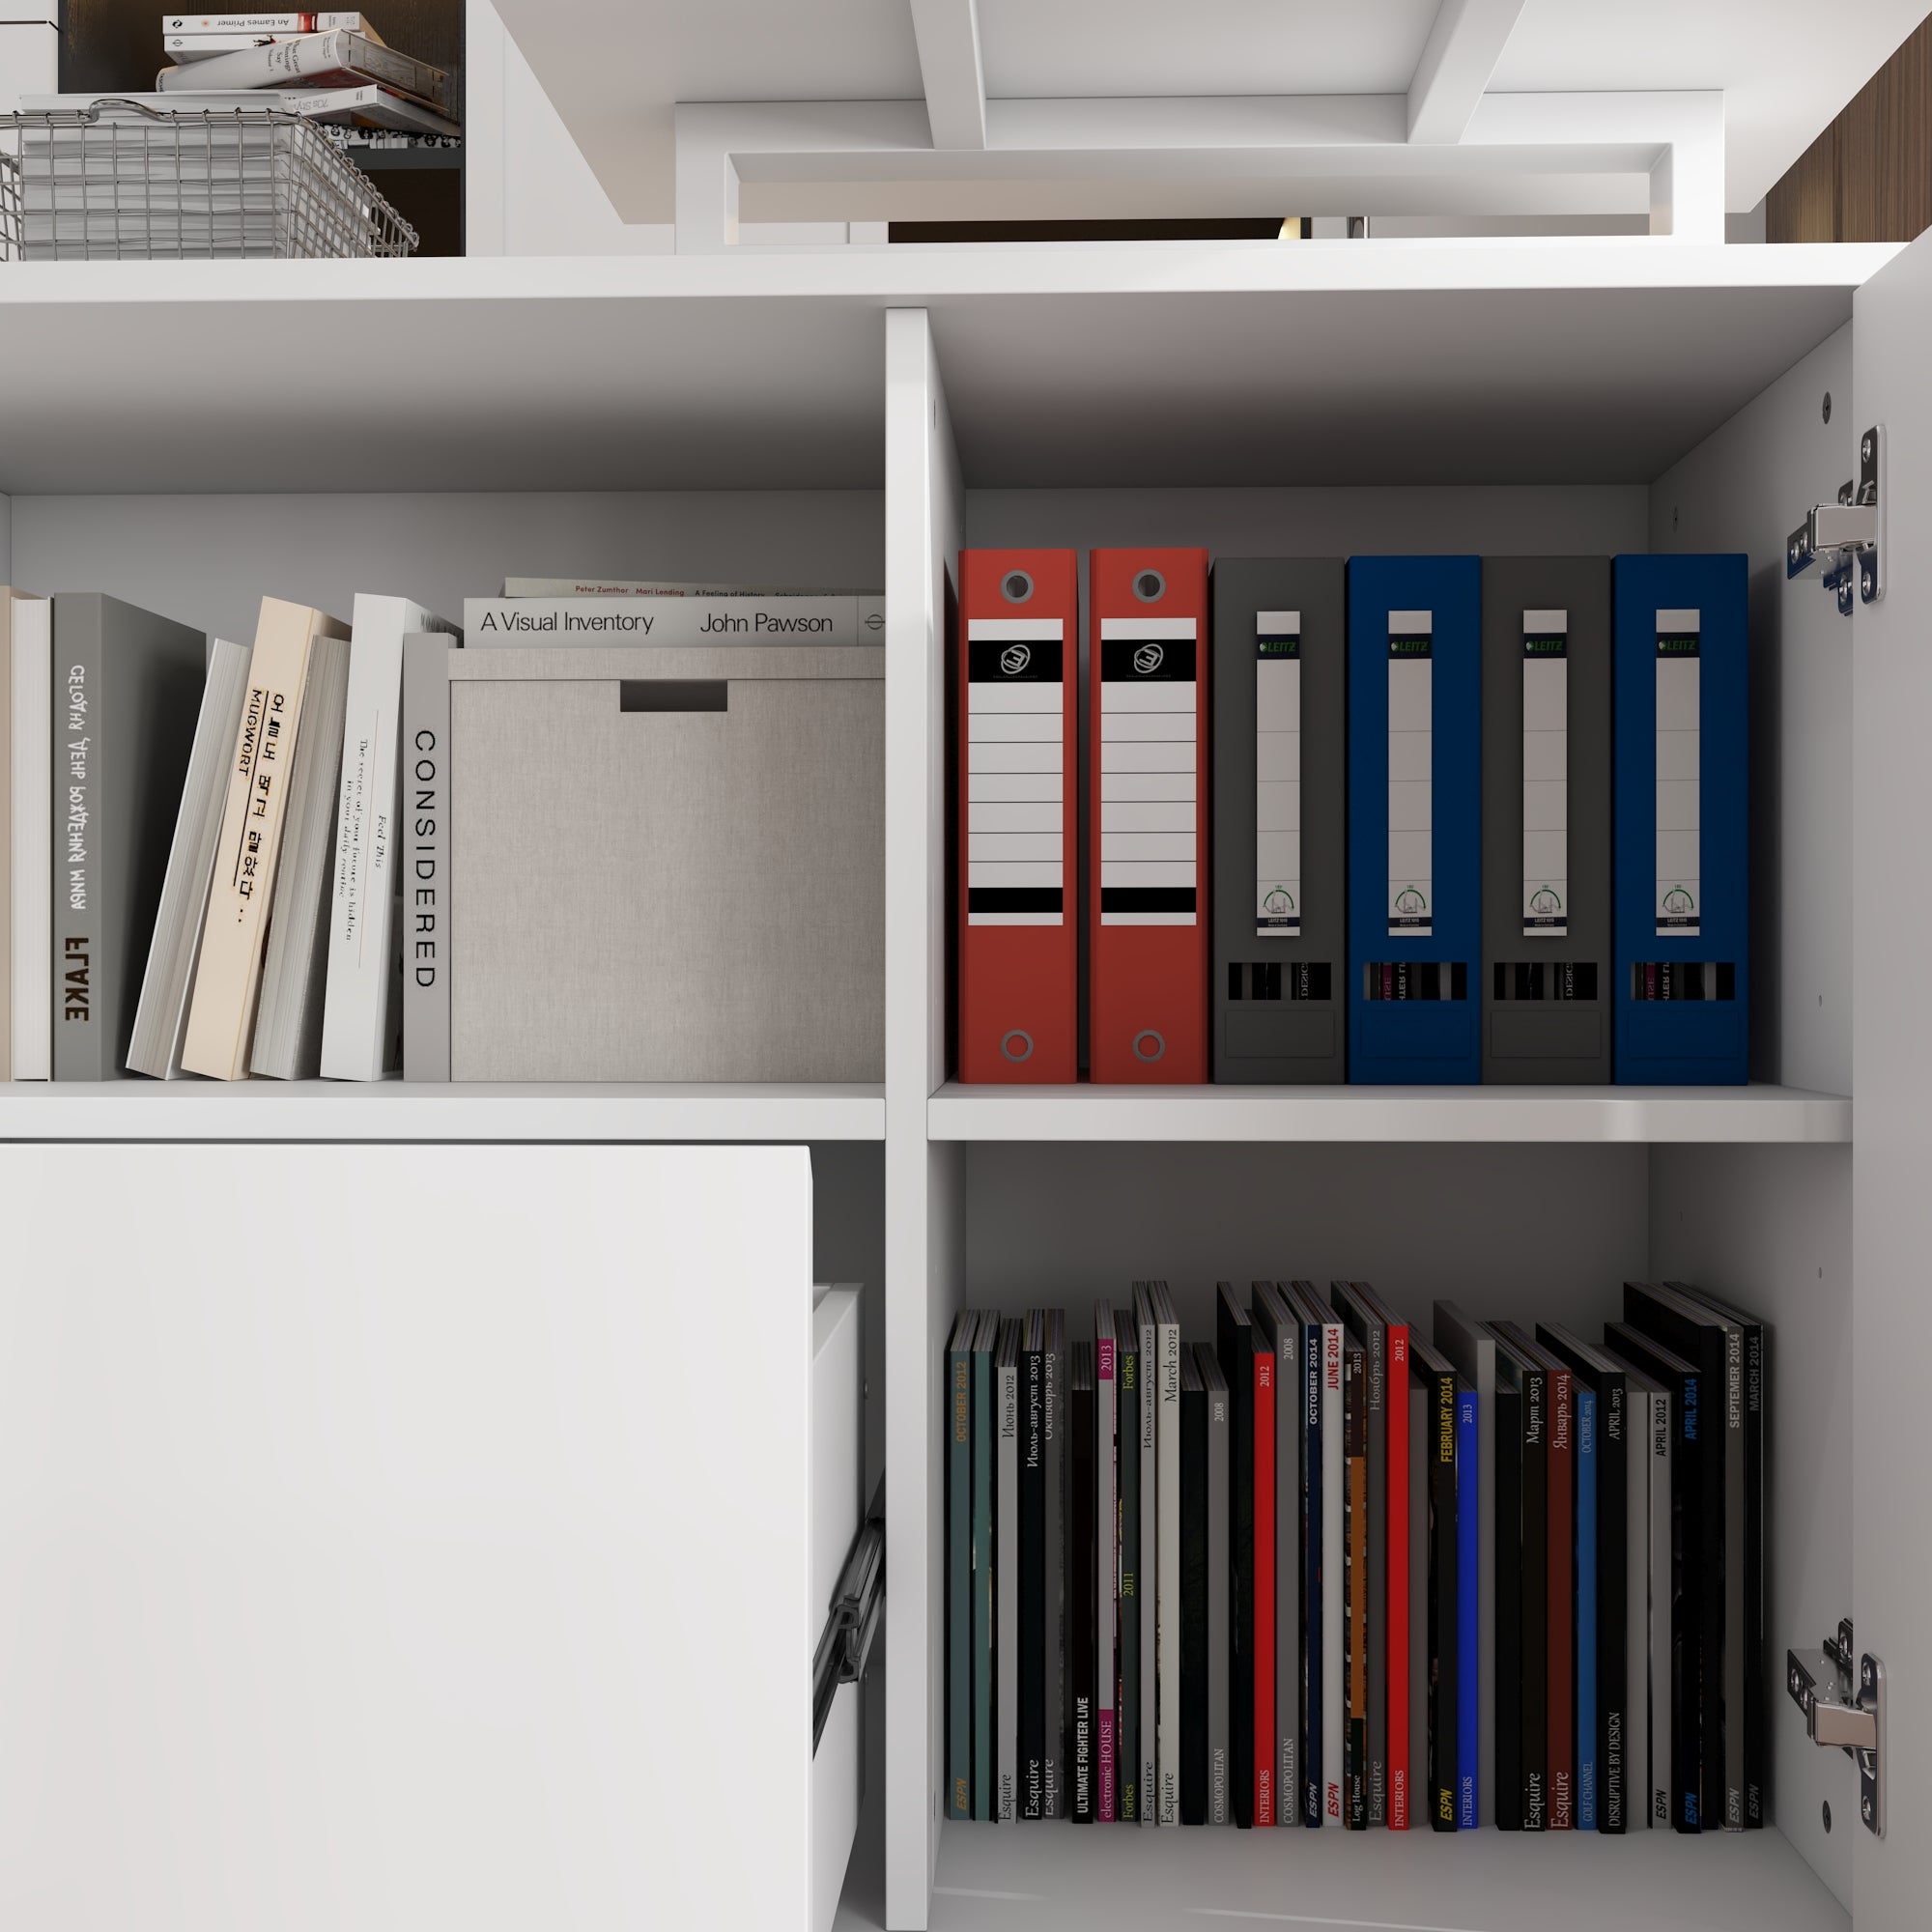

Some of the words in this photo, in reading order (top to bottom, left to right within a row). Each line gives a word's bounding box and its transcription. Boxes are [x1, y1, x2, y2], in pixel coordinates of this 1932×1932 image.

[217, 19, 245, 28] Primer
[292, 55, 301, 73] Great
[313, 98, 328, 109] 70s
[575, 585, 596, 593] Peter
[597, 586, 629, 594] Zumthor
[481, 612, 497, 632] A
[500, 611, 558, 632] Visual
[564, 611, 654, 636] Inventory
[700, 612, 749, 634] John
[755, 613, 834, 633] Pawson
[1268, 642, 1297, 653] LEITZ
[1400, 641, 1429, 652] LEITZ
[1534, 641, 1563, 652] LEITZ
[1667, 640, 1696, 651] LEITZ
[239, 689, 262, 777] MUGWORT
[359, 740, 368, 758] The
[377, 814, 386, 840] Feel
[375, 845, 385, 869] This
[415, 730, 436, 987] CONSIDERED
[346, 901, 356, 940] hidden
[1101, 1345, 1112, 1371] 2013
[1168, 1329, 1177, 1357] 2012
[1283, 1338, 1294, 1360] 2008
[1309, 1338, 1317, 1368] 2014
[1327, 1329, 1338, 1358] 2014
[1394, 1339, 1404, 1362] 2012
[1729, 1333, 1740, 1364] 2014
[1749, 1336, 1759, 1367] 2014
[955, 1361, 967, 1389] 2012
[1030, 1355, 1041, 1381] 2013
[1045, 1353, 1055, 1379] 2013
[1122, 1355, 1134, 1390] Forbes
[1260, 1366, 1270, 1387] 2012
[1327, 1361, 1338, 1390] JUNE
[1353, 1353, 1362, 1374] 2013
[1006, 1375, 1014, 1400] 2012
[1163, 1360, 1177, 1402] March
[1369, 1361, 1383, 1411] Ноябрь
[1440, 1377, 1453, 1405] 2014
[1531, 1377, 1543, 1403] 2013
[1557, 1374, 1570, 1401] 2014
[1685, 1378, 1697, 1406] 2014
[1729, 1366, 1740, 1428] SEPTEMER
[1749, 1369, 1759, 1411] MARCH
[1143, 1360, 1154, 1449] Июль-август
[1214, 1402, 1224, 1422] 2008
[1309, 1370, 1317, 1425] OCTOBER
[1463, 1404, 1473, 1423] 2013
[1584, 1400, 1595, 1416] 2014
[1612, 1388, 1624, 1408] 2013
[1656, 1399, 1666, 1424] 2012
[955, 1392, 967, 1443] OCTOBER
[1002, 1403, 1014, 1438] Июнь
[1026, 1384, 1042, 1468] Июль-август
[1525, 1406, 1544, 1444] Март
[1552, 1403, 1572, 1449] Январь
[1609, 1408, 1620, 1440] APRIL
[1685, 1407, 1697, 1440] APRIL
[1440, 1406, 1453, 1463] FEBRUARY
[1581, 1416, 1592, 1453] OCTOBER
[1656, 1427, 1666, 1457] APRIL
[1123, 1572, 1134, 1597] 2011
[1077, 1697, 1089, 1719] LIVE
[1077, 1721, 1089, 1763] FIGHTER
[1101, 1720, 1112, 1763] HOUSE
[1608, 1712, 1621, 1750] DESIGN
[1608, 1752, 1621, 1765] BY
[956, 1777, 966, 1810] ESPN
[1025, 1759, 1043, 1817] Esquire
[1045, 1759, 1059, 1816] Esquire
[1077, 1765, 1089, 1814] ULTIMATE
[1100, 1766, 1112, 1818] electronic
[1143, 1762, 1154, 1822] Esquire
[1214, 1748, 1224, 1823] COSMOPOLITAN
[1259, 1769, 1270, 1824] INTERIORS
[1283, 1738, 1293, 1824] COSMOPOLITAN
[1353, 1775, 1361, 1803] House
[1369, 1761, 1385, 1821] Esquire
[1583, 1762, 1593, 1800] CHANNEL
[1608, 1767, 1621, 1827] DISRUPTIVE
[998, 1775, 1016, 1820] Esquire
[1122, 1784, 1134, 1819] Forbes
[1161, 1773, 1178, 1823] Esquire
[1309, 1782, 1318, 1818] ESPN
[1328, 1782, 1339, 1817] ESPN
[1353, 1804, 1364, 1822] Log
[1394, 1770, 1405, 1827] INTERIORS
[1439, 1788, 1453, 1821] ESPN
[1462, 1776, 1473, 1826] INTERIORS
[1524, 1773, 1545, 1830] Esquire
[1550, 1771, 1572, 1829] Esquire
[1583, 1800, 1593, 1822] GOLF
[1656, 1789, 1666, 1819] ESPN
[1684, 1791, 1697, 1824] ESPN
[1729, 1787, 1739, 1823] ESPN
[1748, 1783, 1759, 1819] ESPN
